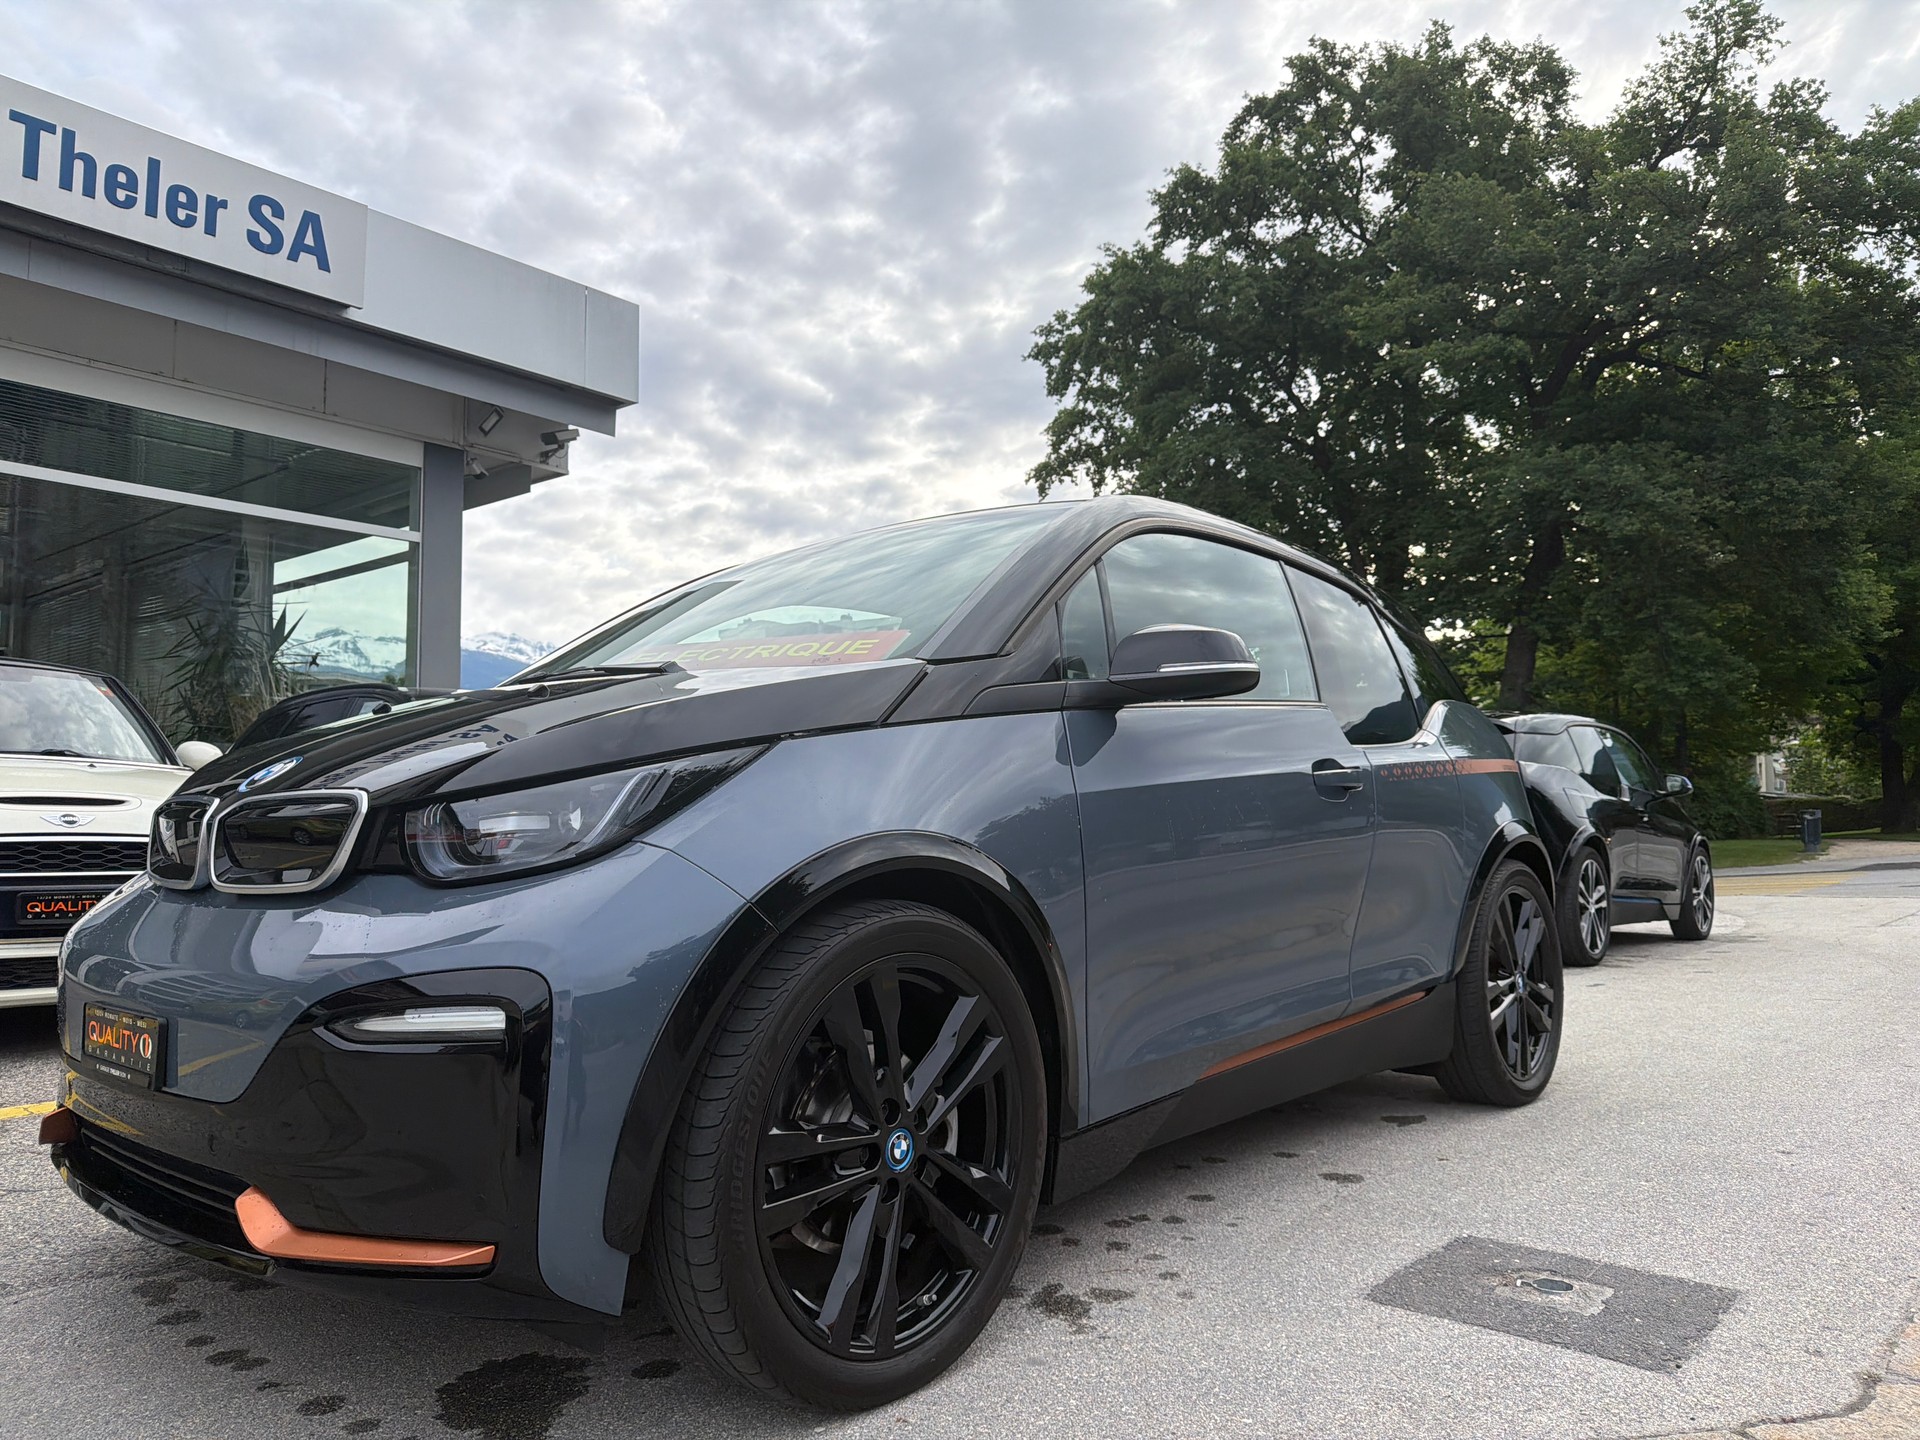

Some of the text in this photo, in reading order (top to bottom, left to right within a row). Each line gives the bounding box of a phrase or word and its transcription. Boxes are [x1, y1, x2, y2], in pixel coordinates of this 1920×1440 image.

[9, 108, 331, 273] Theler SA
[26, 900, 98, 912] QUALIT
[88, 1020, 139, 1054] QUALITY
[88, 1045, 151, 1071] GARANTIE
